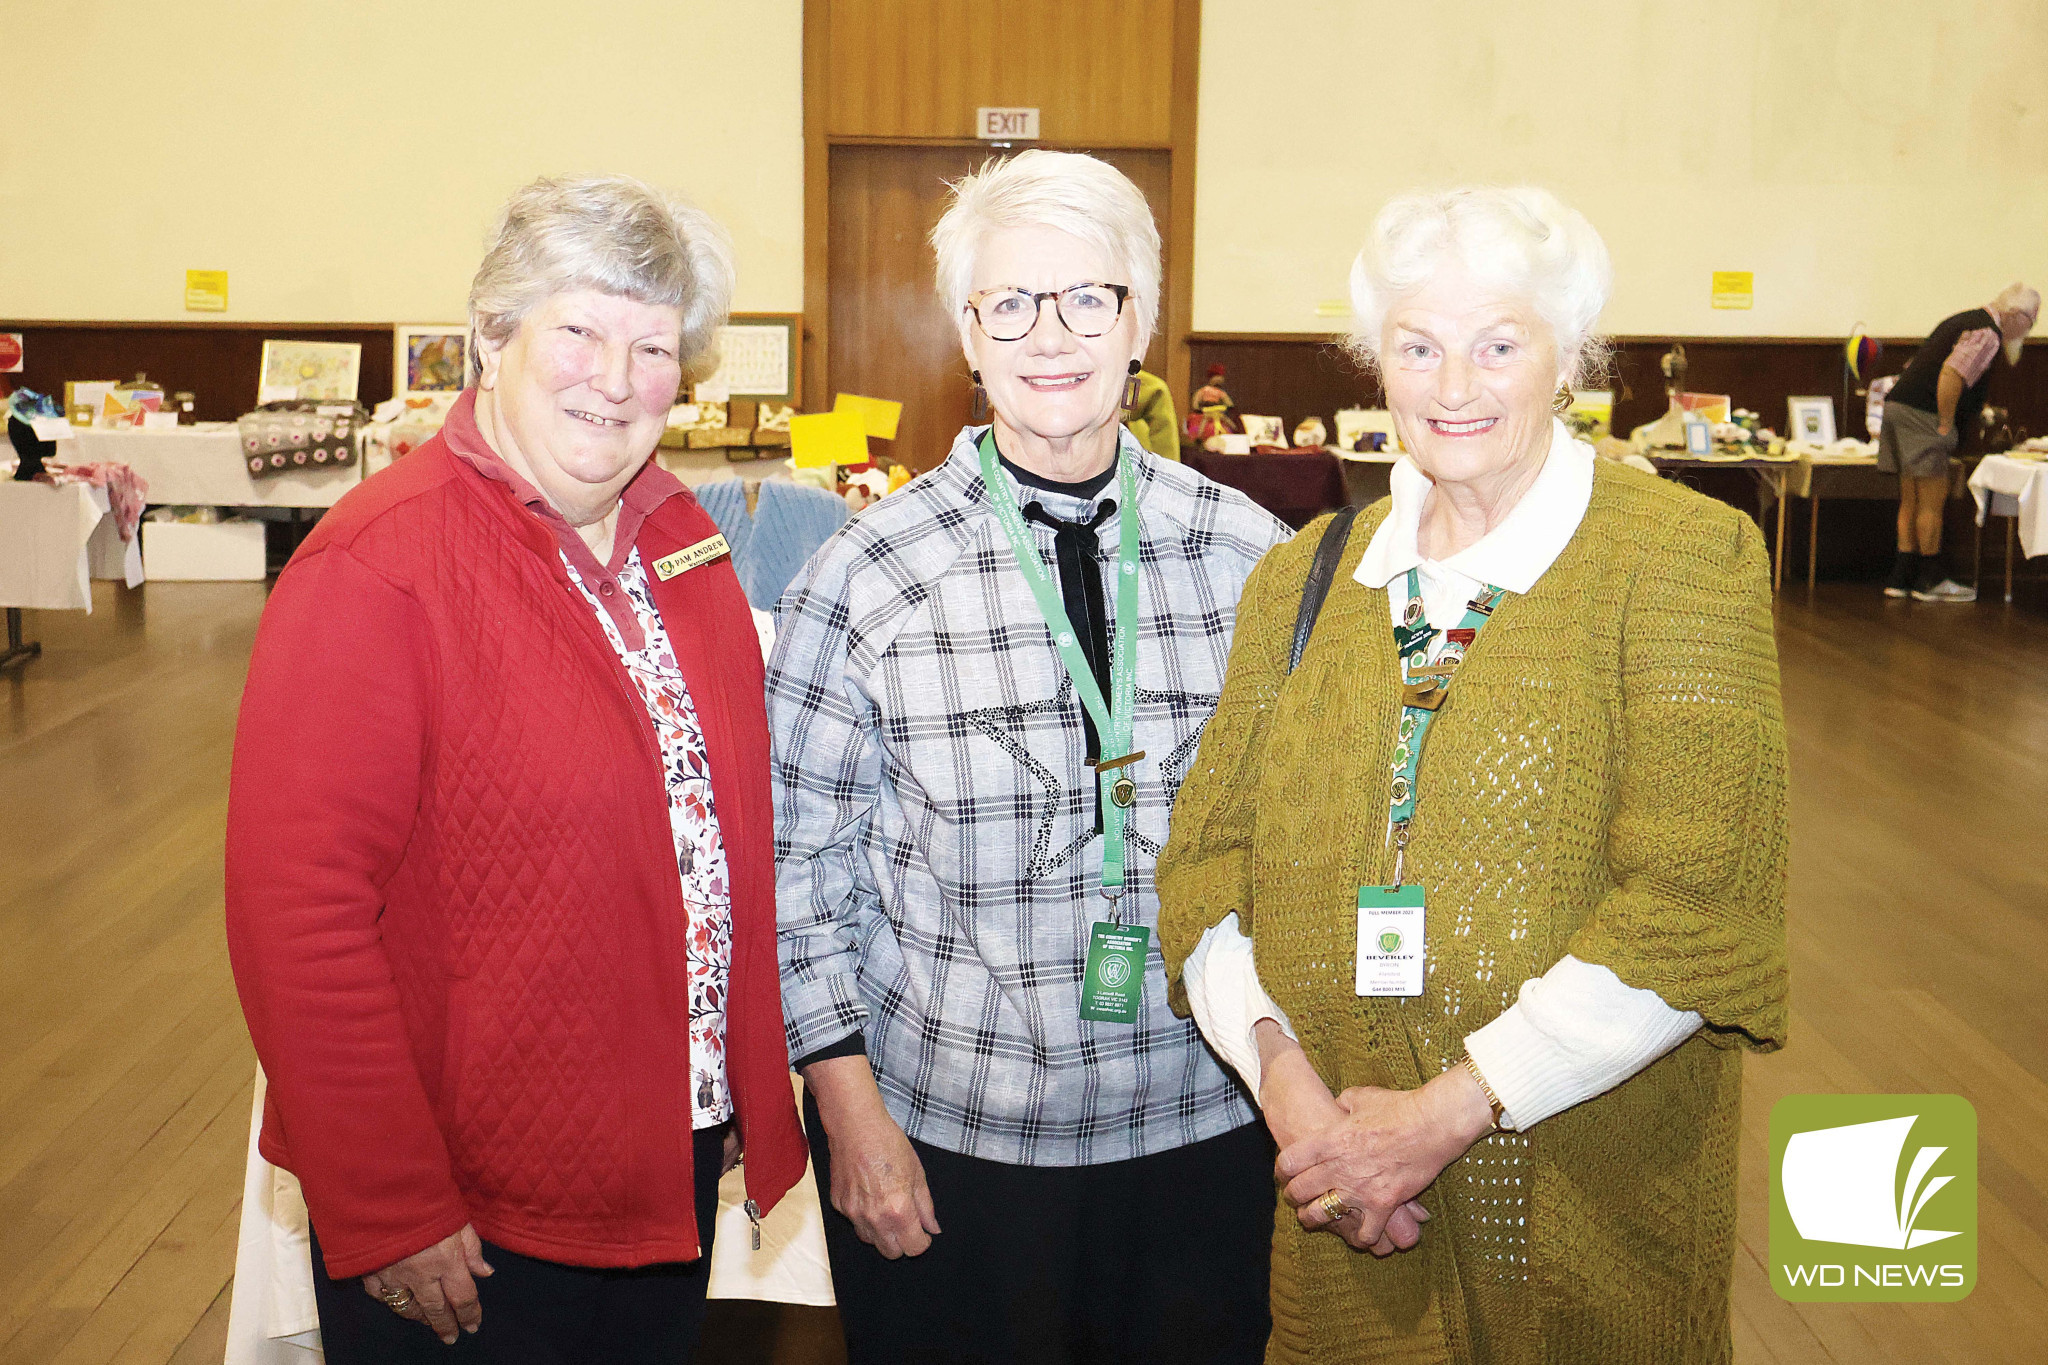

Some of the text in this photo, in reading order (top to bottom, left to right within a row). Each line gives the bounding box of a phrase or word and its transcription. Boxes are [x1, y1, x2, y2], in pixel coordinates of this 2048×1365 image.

[987, 112, 1029, 134] EXIT
[992, 492, 1001, 502] OF
[997, 503, 1014, 536] VICTORIA
[993, 469, 1009, 501] COUNTRY
[1006, 501, 1025, 535] WOMEN'S
[1020, 535, 1046, 581] ASSOCIATION
[675, 539, 724, 566] PAM ANDREW
[1116, 626, 1125, 676] ASSOCIATION
[1114, 678, 1123, 715] WOMEN'S
[1124, 683, 1132, 718] VICTORIA
